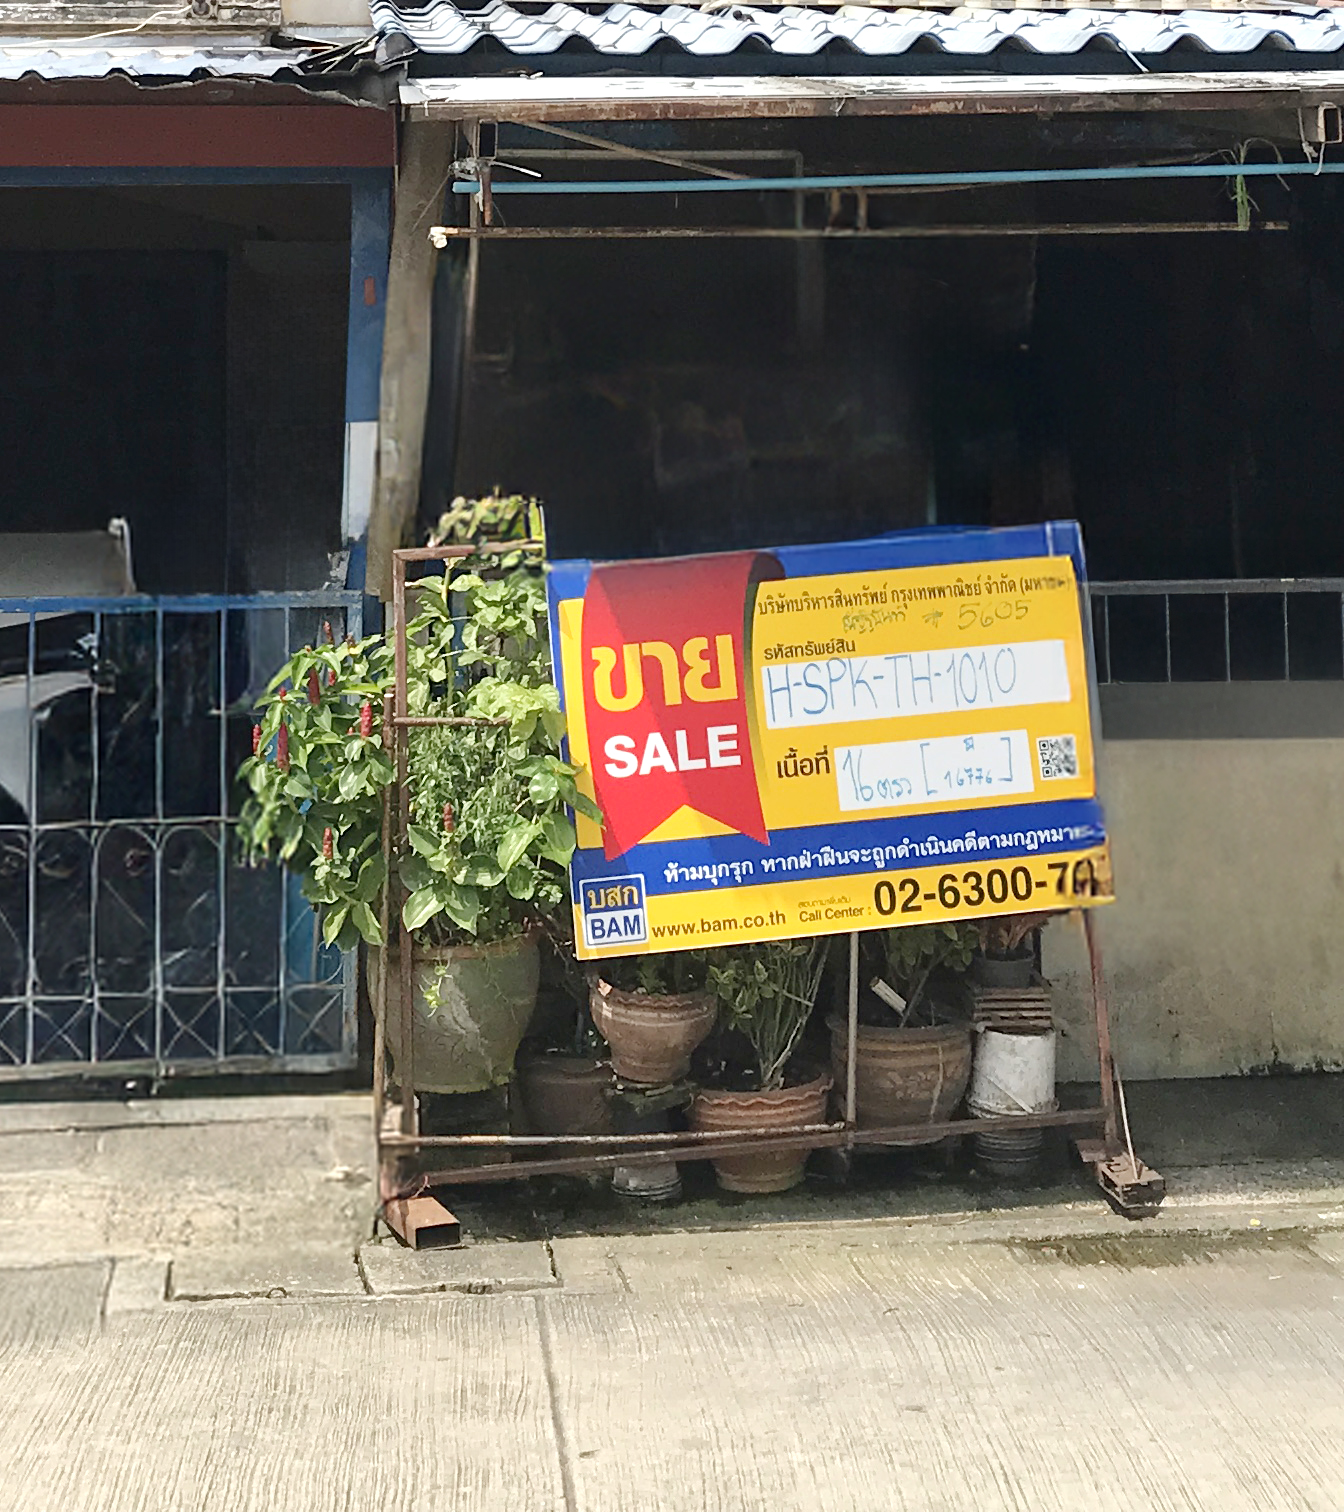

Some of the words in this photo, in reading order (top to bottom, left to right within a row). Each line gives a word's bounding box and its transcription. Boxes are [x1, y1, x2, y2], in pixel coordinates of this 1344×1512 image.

[758, 583, 888, 616] บริษัทบริหารสินทรัพย์
[891, 574, 982, 609] กรุงเทพพาณิชย์
[985, 574, 1017, 596] จำกัด
[958, 599, 1033, 630] 5605
[763, 638, 857, 661] รหัสทรัพย์สิน
[591, 633, 739, 713] ขาย
[766, 646, 1017, 723] H-SPK-TH-1010
[604, 724, 742, 778] SALE
[776, 744, 831, 779] เนื้อที่
[664, 859, 754, 886] ห้ามบุกรุก
[761, 826, 1093, 873] หากฝ่าฝืนจะถูกดำเนินคดีตามกฎหมา
[587, 884, 640, 910] บสก
[590, 914, 642, 939] BAM
[652, 910, 786, 937] www.bam.co.th
[799, 909, 822, 922] Call
[825, 906, 864, 919] Center
